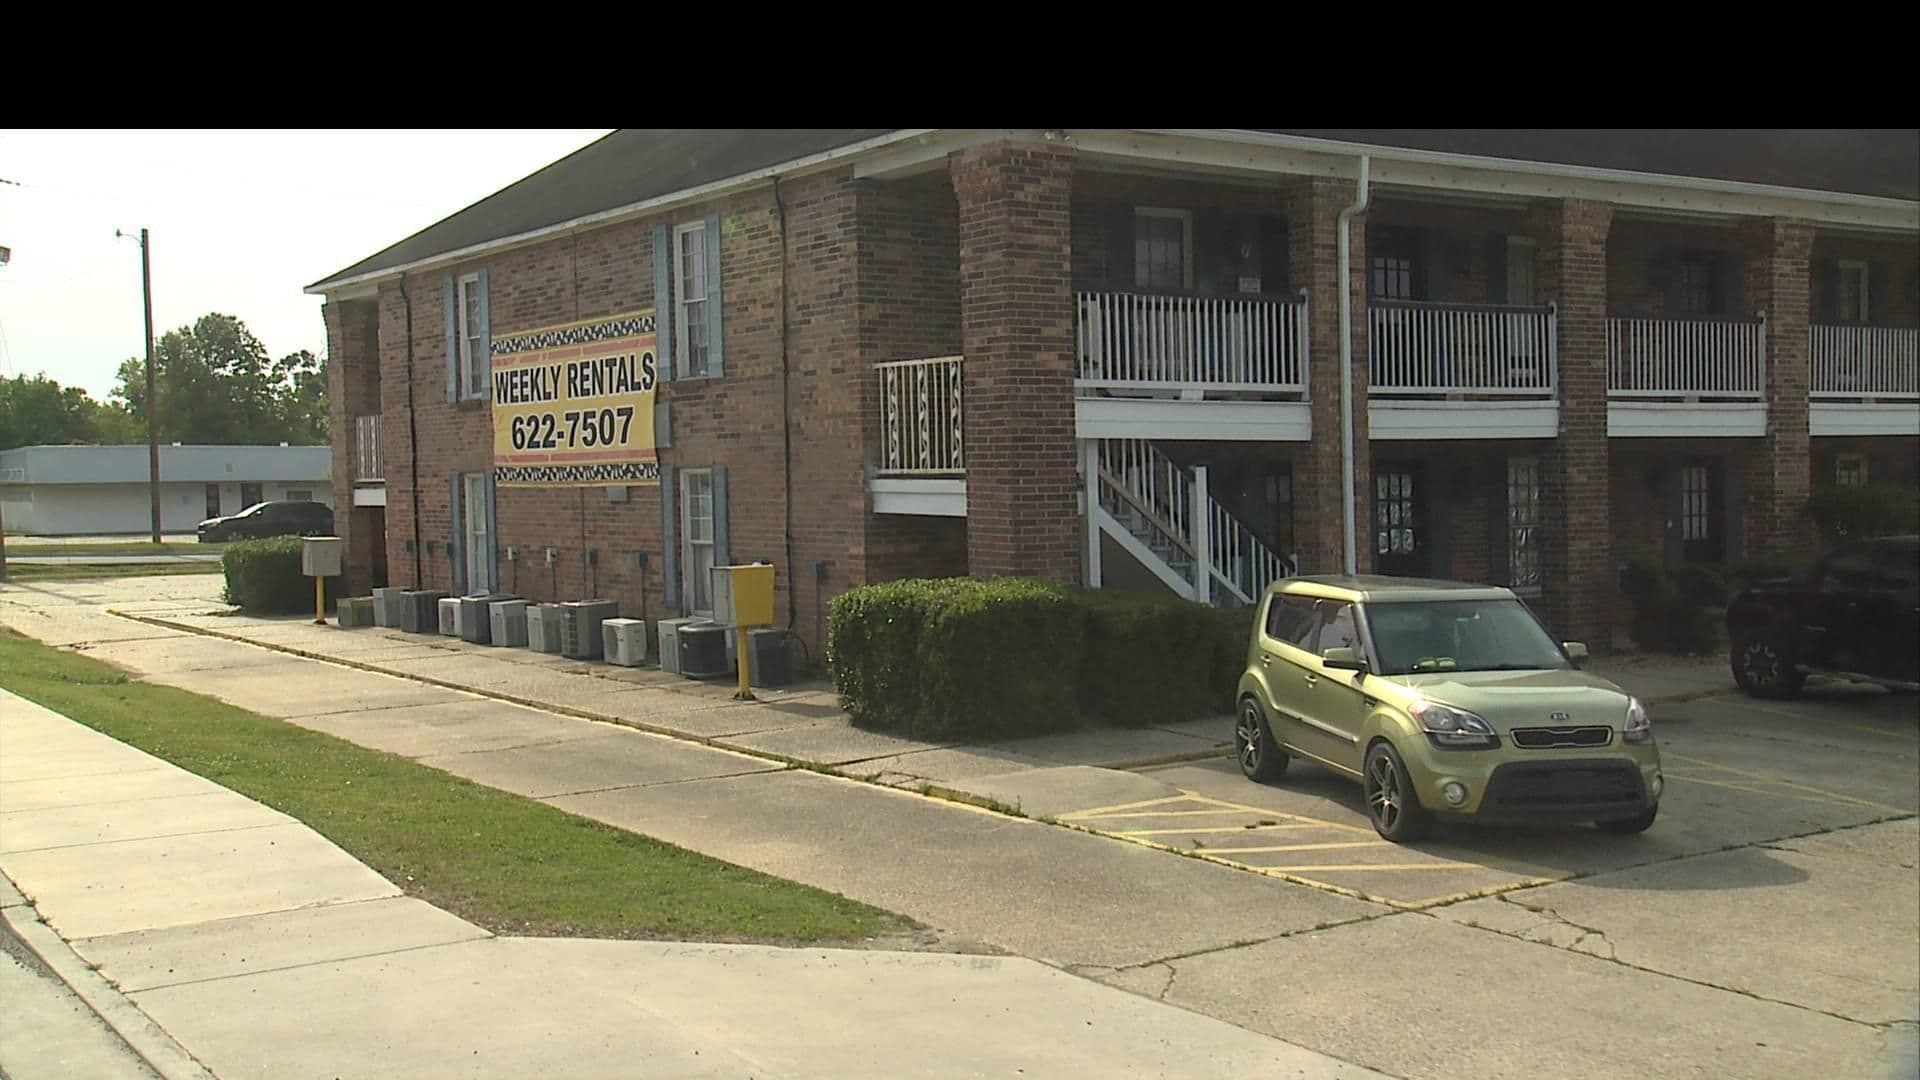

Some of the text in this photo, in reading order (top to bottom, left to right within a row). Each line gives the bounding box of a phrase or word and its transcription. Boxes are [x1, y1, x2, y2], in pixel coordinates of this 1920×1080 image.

[495, 351, 656, 405] WEEKLY RENTALS
[511, 406, 634, 450] 622-7507
